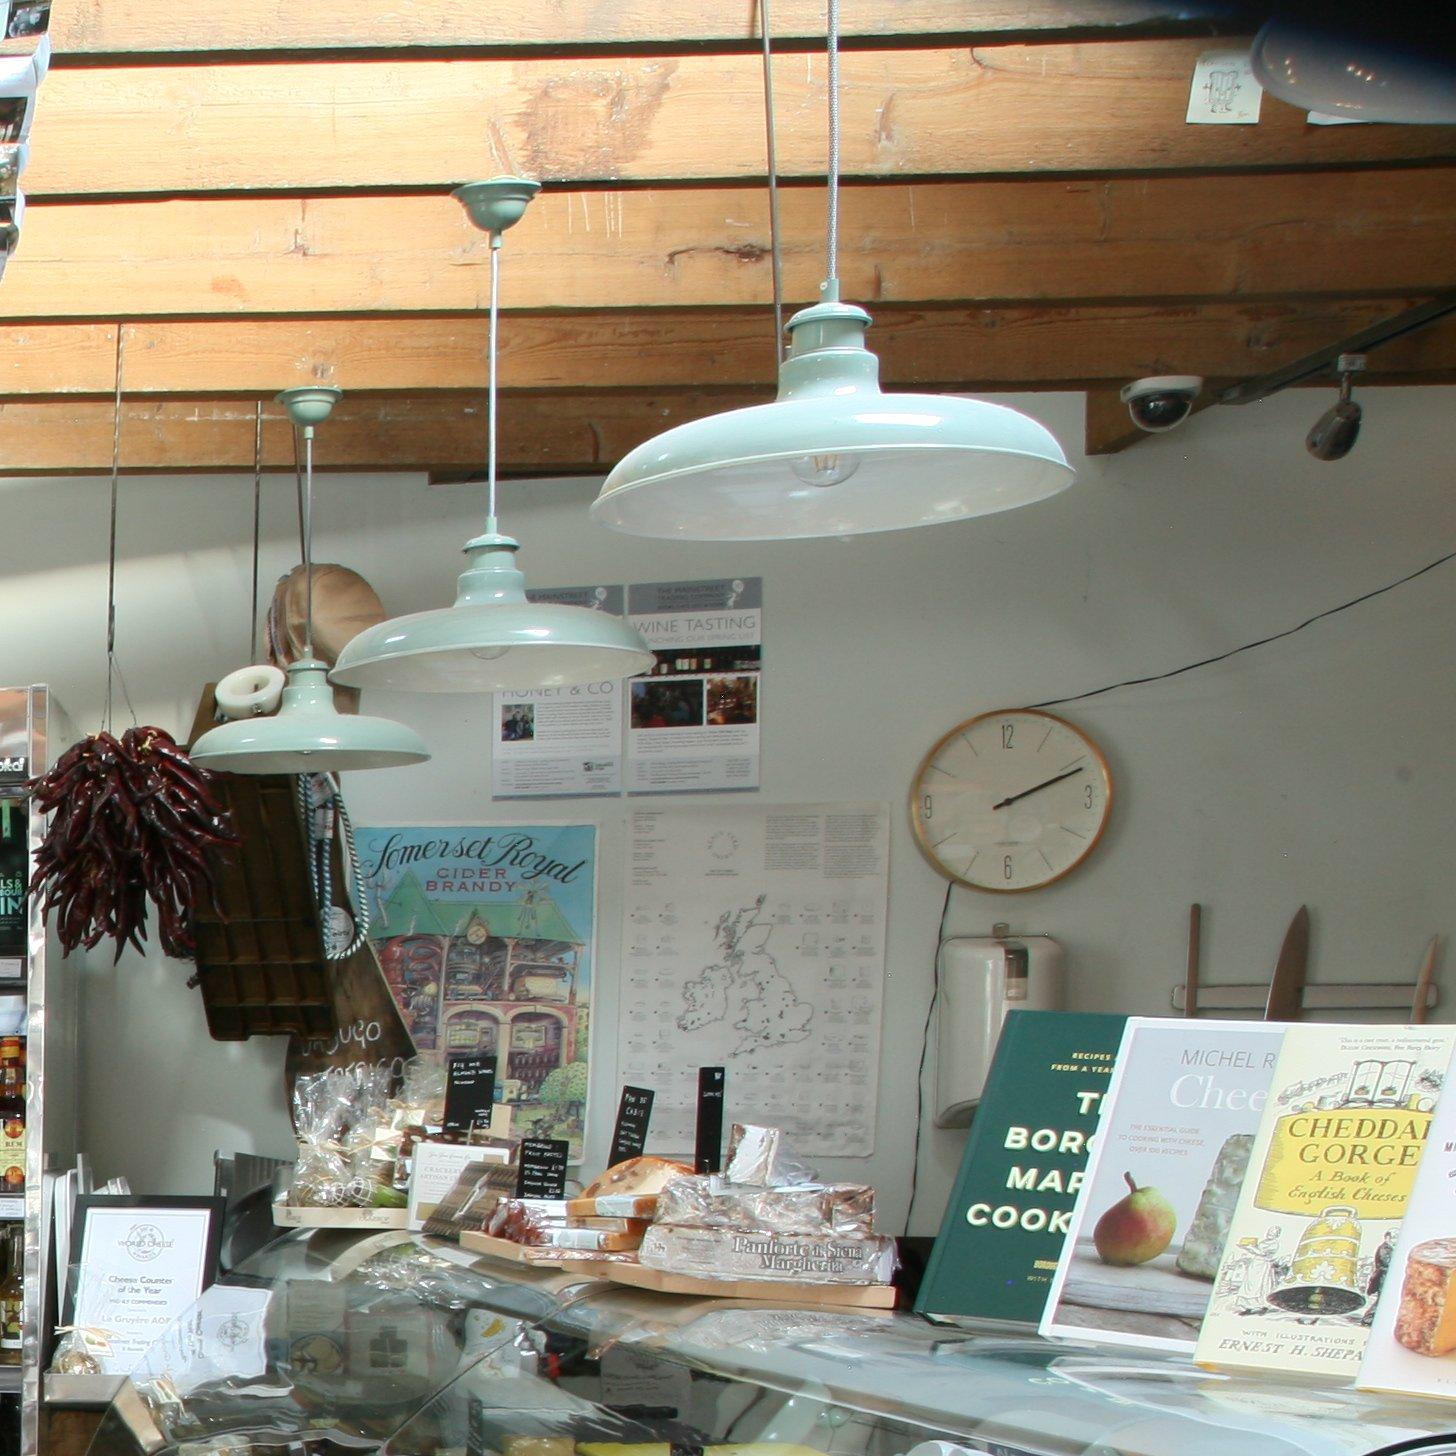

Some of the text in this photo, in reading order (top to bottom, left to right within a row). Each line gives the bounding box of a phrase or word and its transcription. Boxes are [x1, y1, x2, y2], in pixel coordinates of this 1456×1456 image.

[632, 615, 756, 634] WINE TASTING
[588, 681, 614, 695] CO
[1001, 724, 1014, 750] 12
[1084, 784, 1093, 810] 3
[924, 794, 933, 820] 9
[363, 832, 589, 884] Somerset Royal
[1004, 855, 1012, 880] 6
[437, 867, 507, 879] CIDER
[11, 880, 23, 890] &
[426, 881, 517, 892] BRANDY
[1050, 1064, 1078, 1073] FROM
[1181, 1049, 1256, 1069] MICHEL
[1299, 1143, 1421, 1167] GORGE
[1309, 1170, 1396, 1185] A Book of
[1288, 1185, 1407, 1205] English Cheeses
[733, 1235, 810, 1258] Panforte
[759, 1255, 844, 1276] Margherita
[108, 1275, 174, 1285] Cheese Counter
[143, 1286, 162, 1295] Year
[1219, 1339, 1285, 1355] ERNEST
[1276, 1333, 1355, 1346] ILLUSTRATIONS
